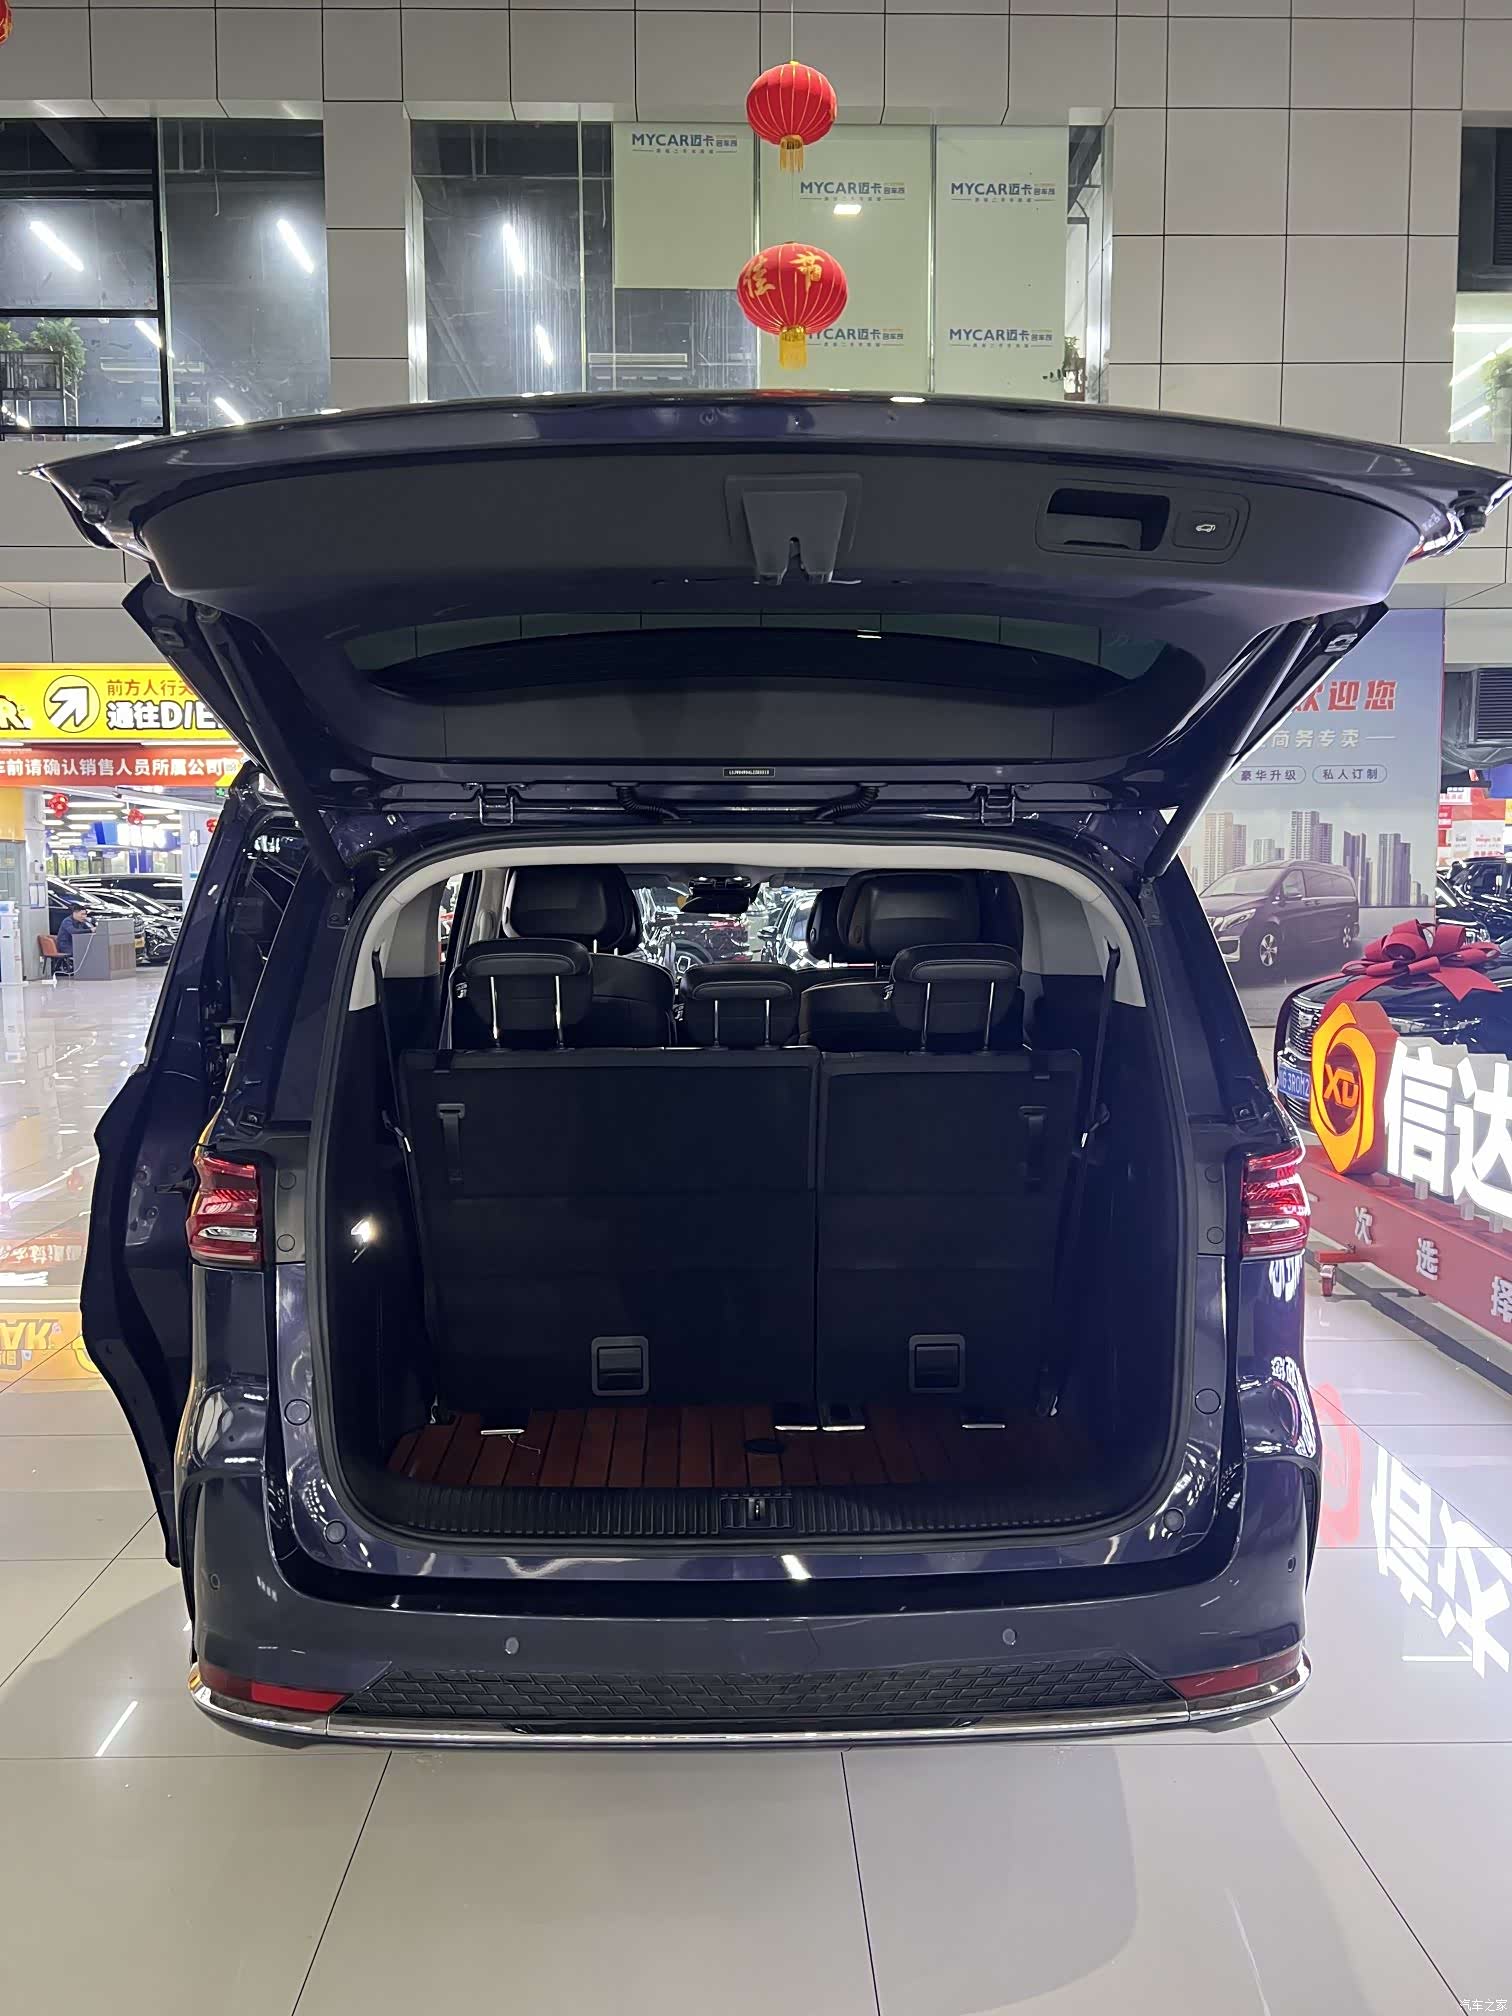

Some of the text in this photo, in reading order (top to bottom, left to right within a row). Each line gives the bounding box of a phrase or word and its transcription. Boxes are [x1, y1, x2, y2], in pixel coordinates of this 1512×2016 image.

[1258, 729, 1359, 748] 商务专卖
[1240, 768, 1378, 782] 豪华升级 私人订制
[1384, 1039, 1512, 1219] 信达
